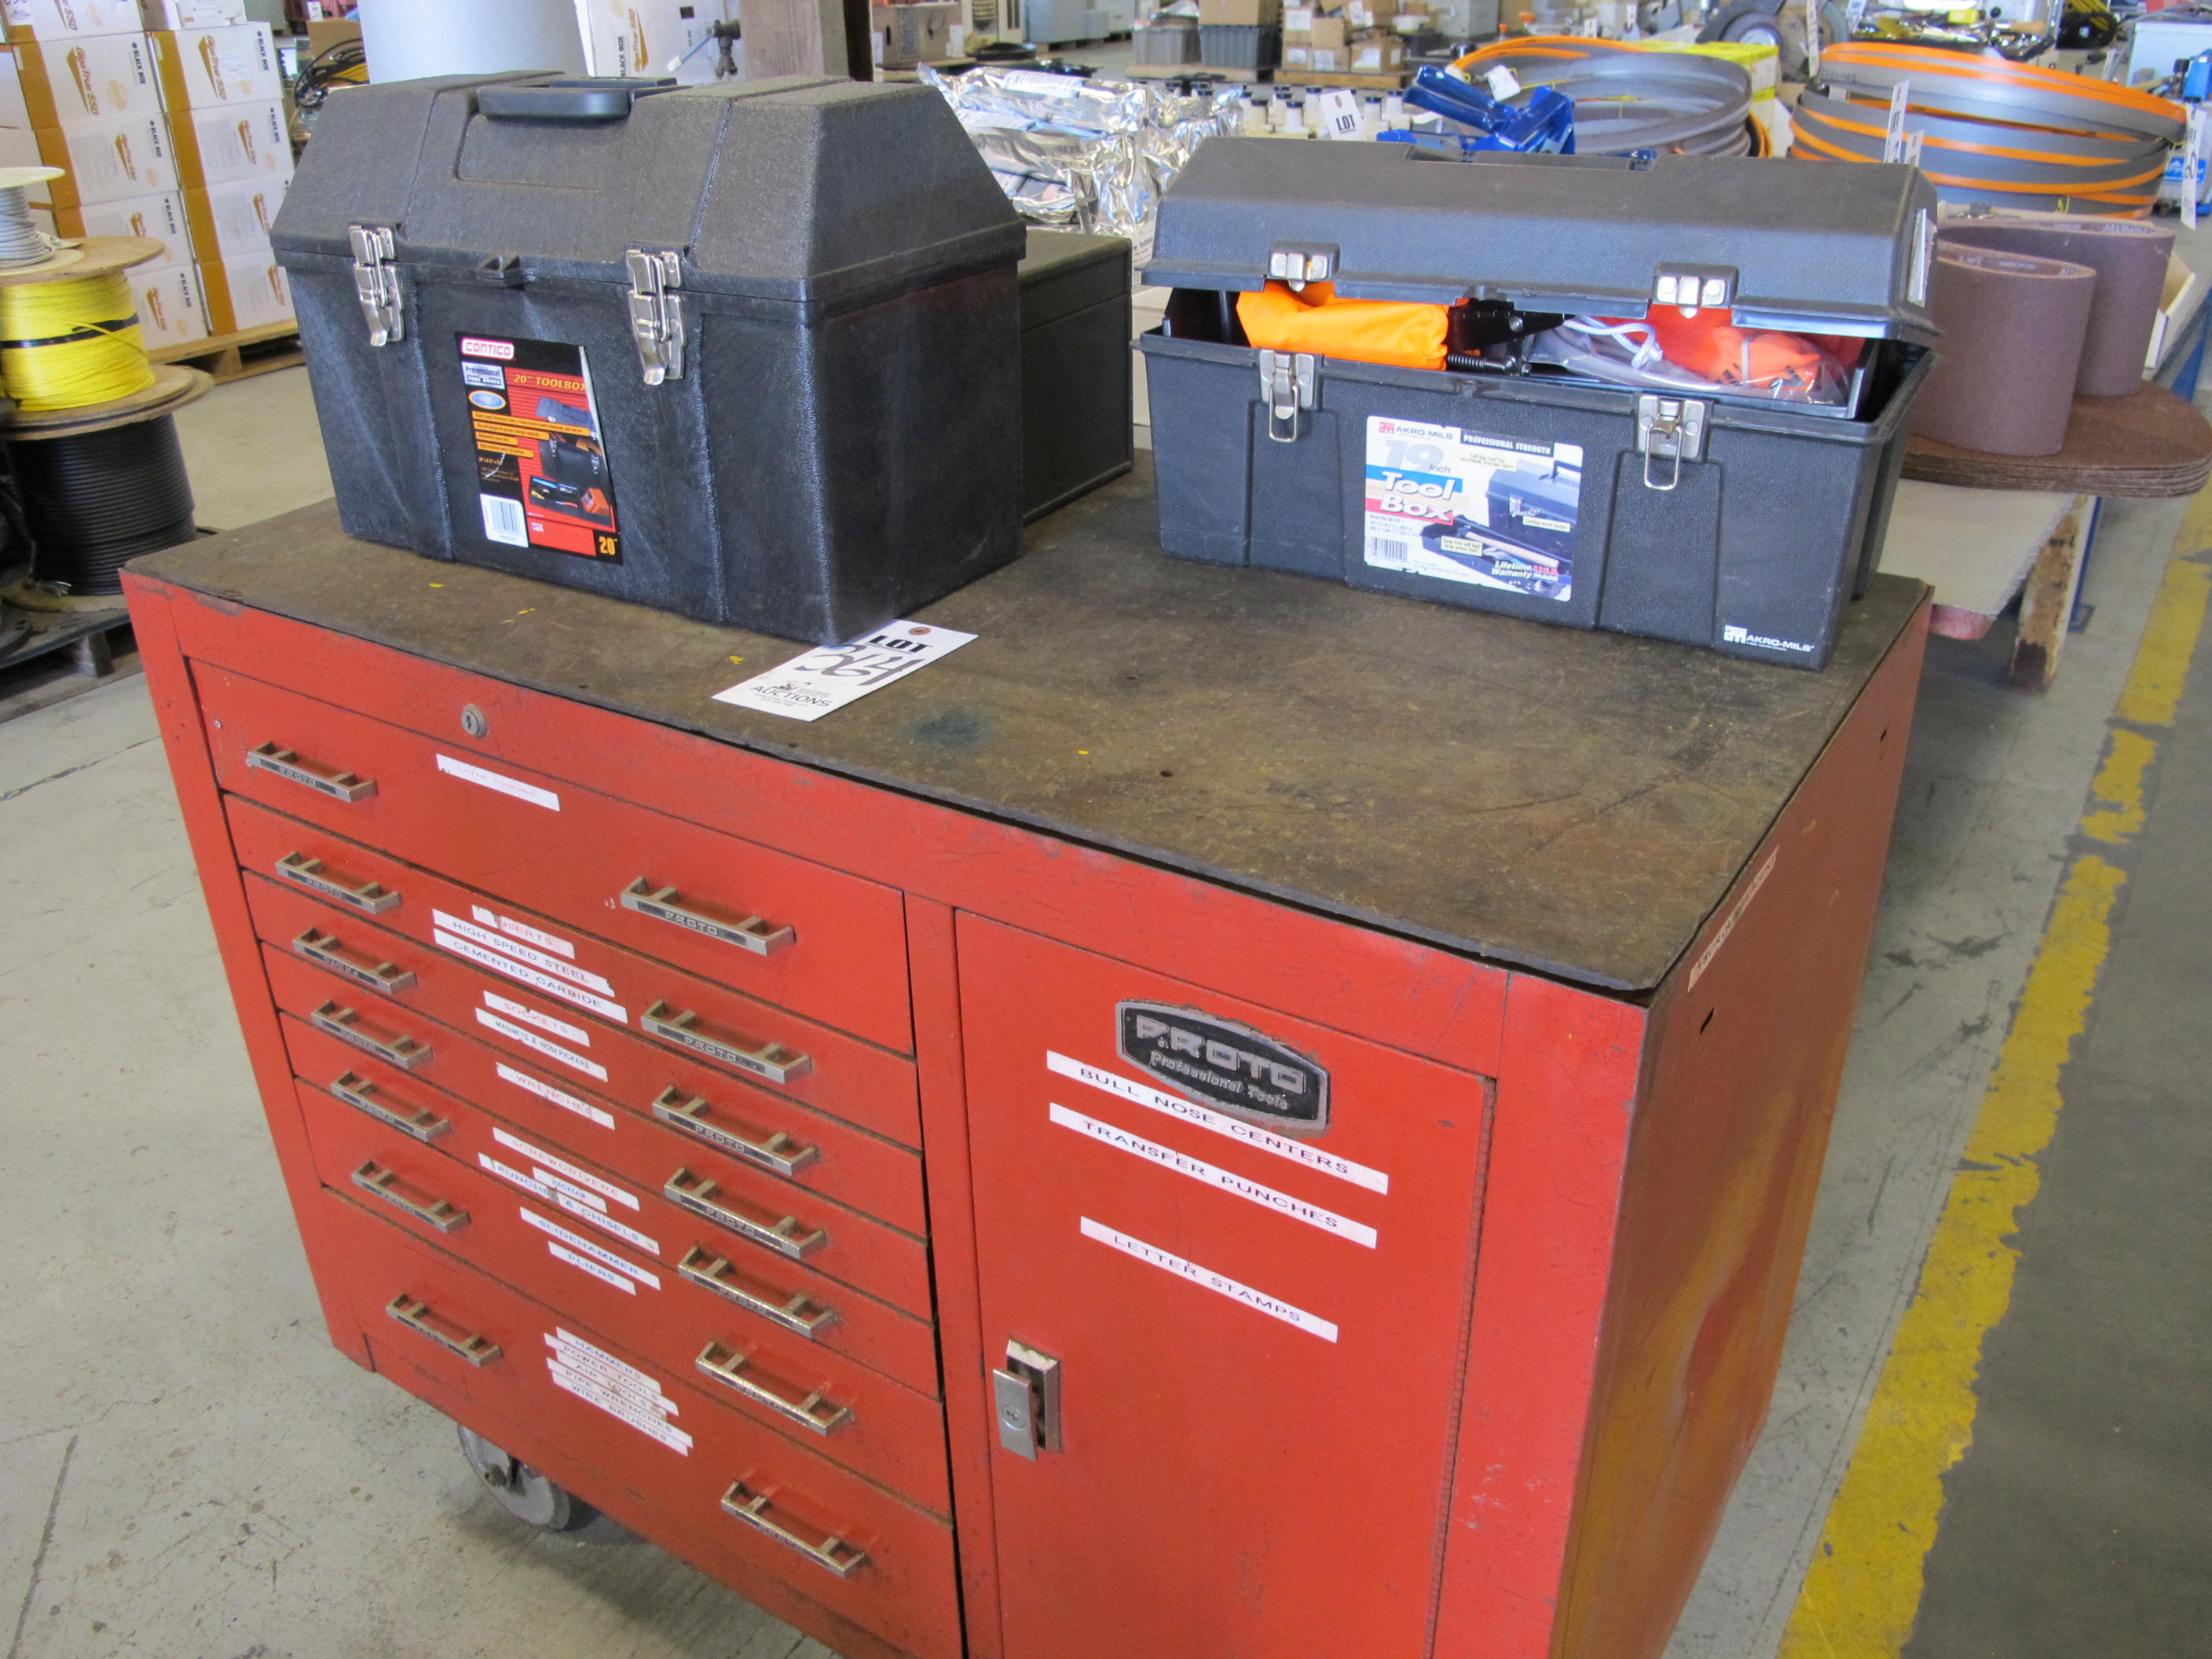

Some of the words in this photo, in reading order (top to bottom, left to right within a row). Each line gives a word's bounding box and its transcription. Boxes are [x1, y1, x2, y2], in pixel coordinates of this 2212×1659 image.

[133, 49, 142, 70] BLACK
[257, 38, 266, 57] BLACK
[87, 93, 100, 115] 550
[150, 126, 159, 145] BLACK
[1335, 115, 1356, 132] LOT
[166, 204, 174, 222] BLACK
[181, 279, 190, 297] BLACK
[1396, 427, 1453, 440] AKRO-MILS
[1463, 434, 1514, 449] PROFESSIONAL
[1515, 438, 1551, 455] STRENGTH
[1385, 440, 1445, 473] 19
[1382, 471, 1456, 500] Tool
[1380, 493, 1453, 522] Box
[1492, 568, 1533, 579] Warranty
[1533, 573, 1559, 581] MADE
[1495, 560, 1532, 571] Lifetime
[1533, 565, 1559, 575] USA
[867, 635, 933, 654] LOT
[1746, 635, 1811, 652] AKRO-MILS
[749, 686, 834, 708] AUCTIONS
[497, 919, 553, 946] NSERTS
[665, 910, 718, 936] PROTO
[453, 921, 486, 941] HIGH
[493, 938, 537, 961] SPEED
[544, 959, 590, 983] STEEL
[453, 940, 529, 978] CEMENTED
[536, 976, 602, 1008] CARBIDE
[504, 1002, 568, 1034] SOCKETS
[495, 1020, 529, 1042] MAGNETS
[540, 1039, 591, 1070] NOSEPICKERS
[684, 1036, 737, 1062] PROTO
[1136, 1015, 1307, 1093] PROTO
[1150, 1049, 1243, 1094] Professional
[1247, 1085, 1289, 1111] Tools
[516, 1075, 593, 1117] WRENCHES
[1080, 1068, 1140, 1097] BULL
[1154, 1096, 1216, 1125] NOSE
[1231, 1125, 1349, 1175] CENTERS
[694, 1124, 745, 1152] PROTO
[512, 1138, 619, 1197] SCREWDRIVERS
[1082, 1120, 1206, 1177] TRANSFER
[1221, 1175, 1339, 1228] PUNCHES
[565, 1199, 574, 1209] &
[581, 1207, 639, 1242] CHISELS
[707, 1208, 754, 1236] PROTO
[539, 1219, 639, 1276] SLIDEHAMMER
[568, 1254, 615, 1282] PLIERS
[1114, 1235, 1197, 1277] LETTER
[1211, 1276, 1301, 1322] STAMPS
[563, 1346, 608, 1373] POWER
[617, 1375, 658, 1401] TOOLS
[575, 1339, 642, 1380] HAMMERS
[576, 1364, 597, 1378] AIR
[607, 1381, 647, 1407] TOOLS
[566, 1370, 591, 1386] PIPE
[600, 1390, 672, 1433] WRENCHES
[570, 1383, 602, 1404] WIRE
[608, 1404, 668, 1441] BRUSHES
